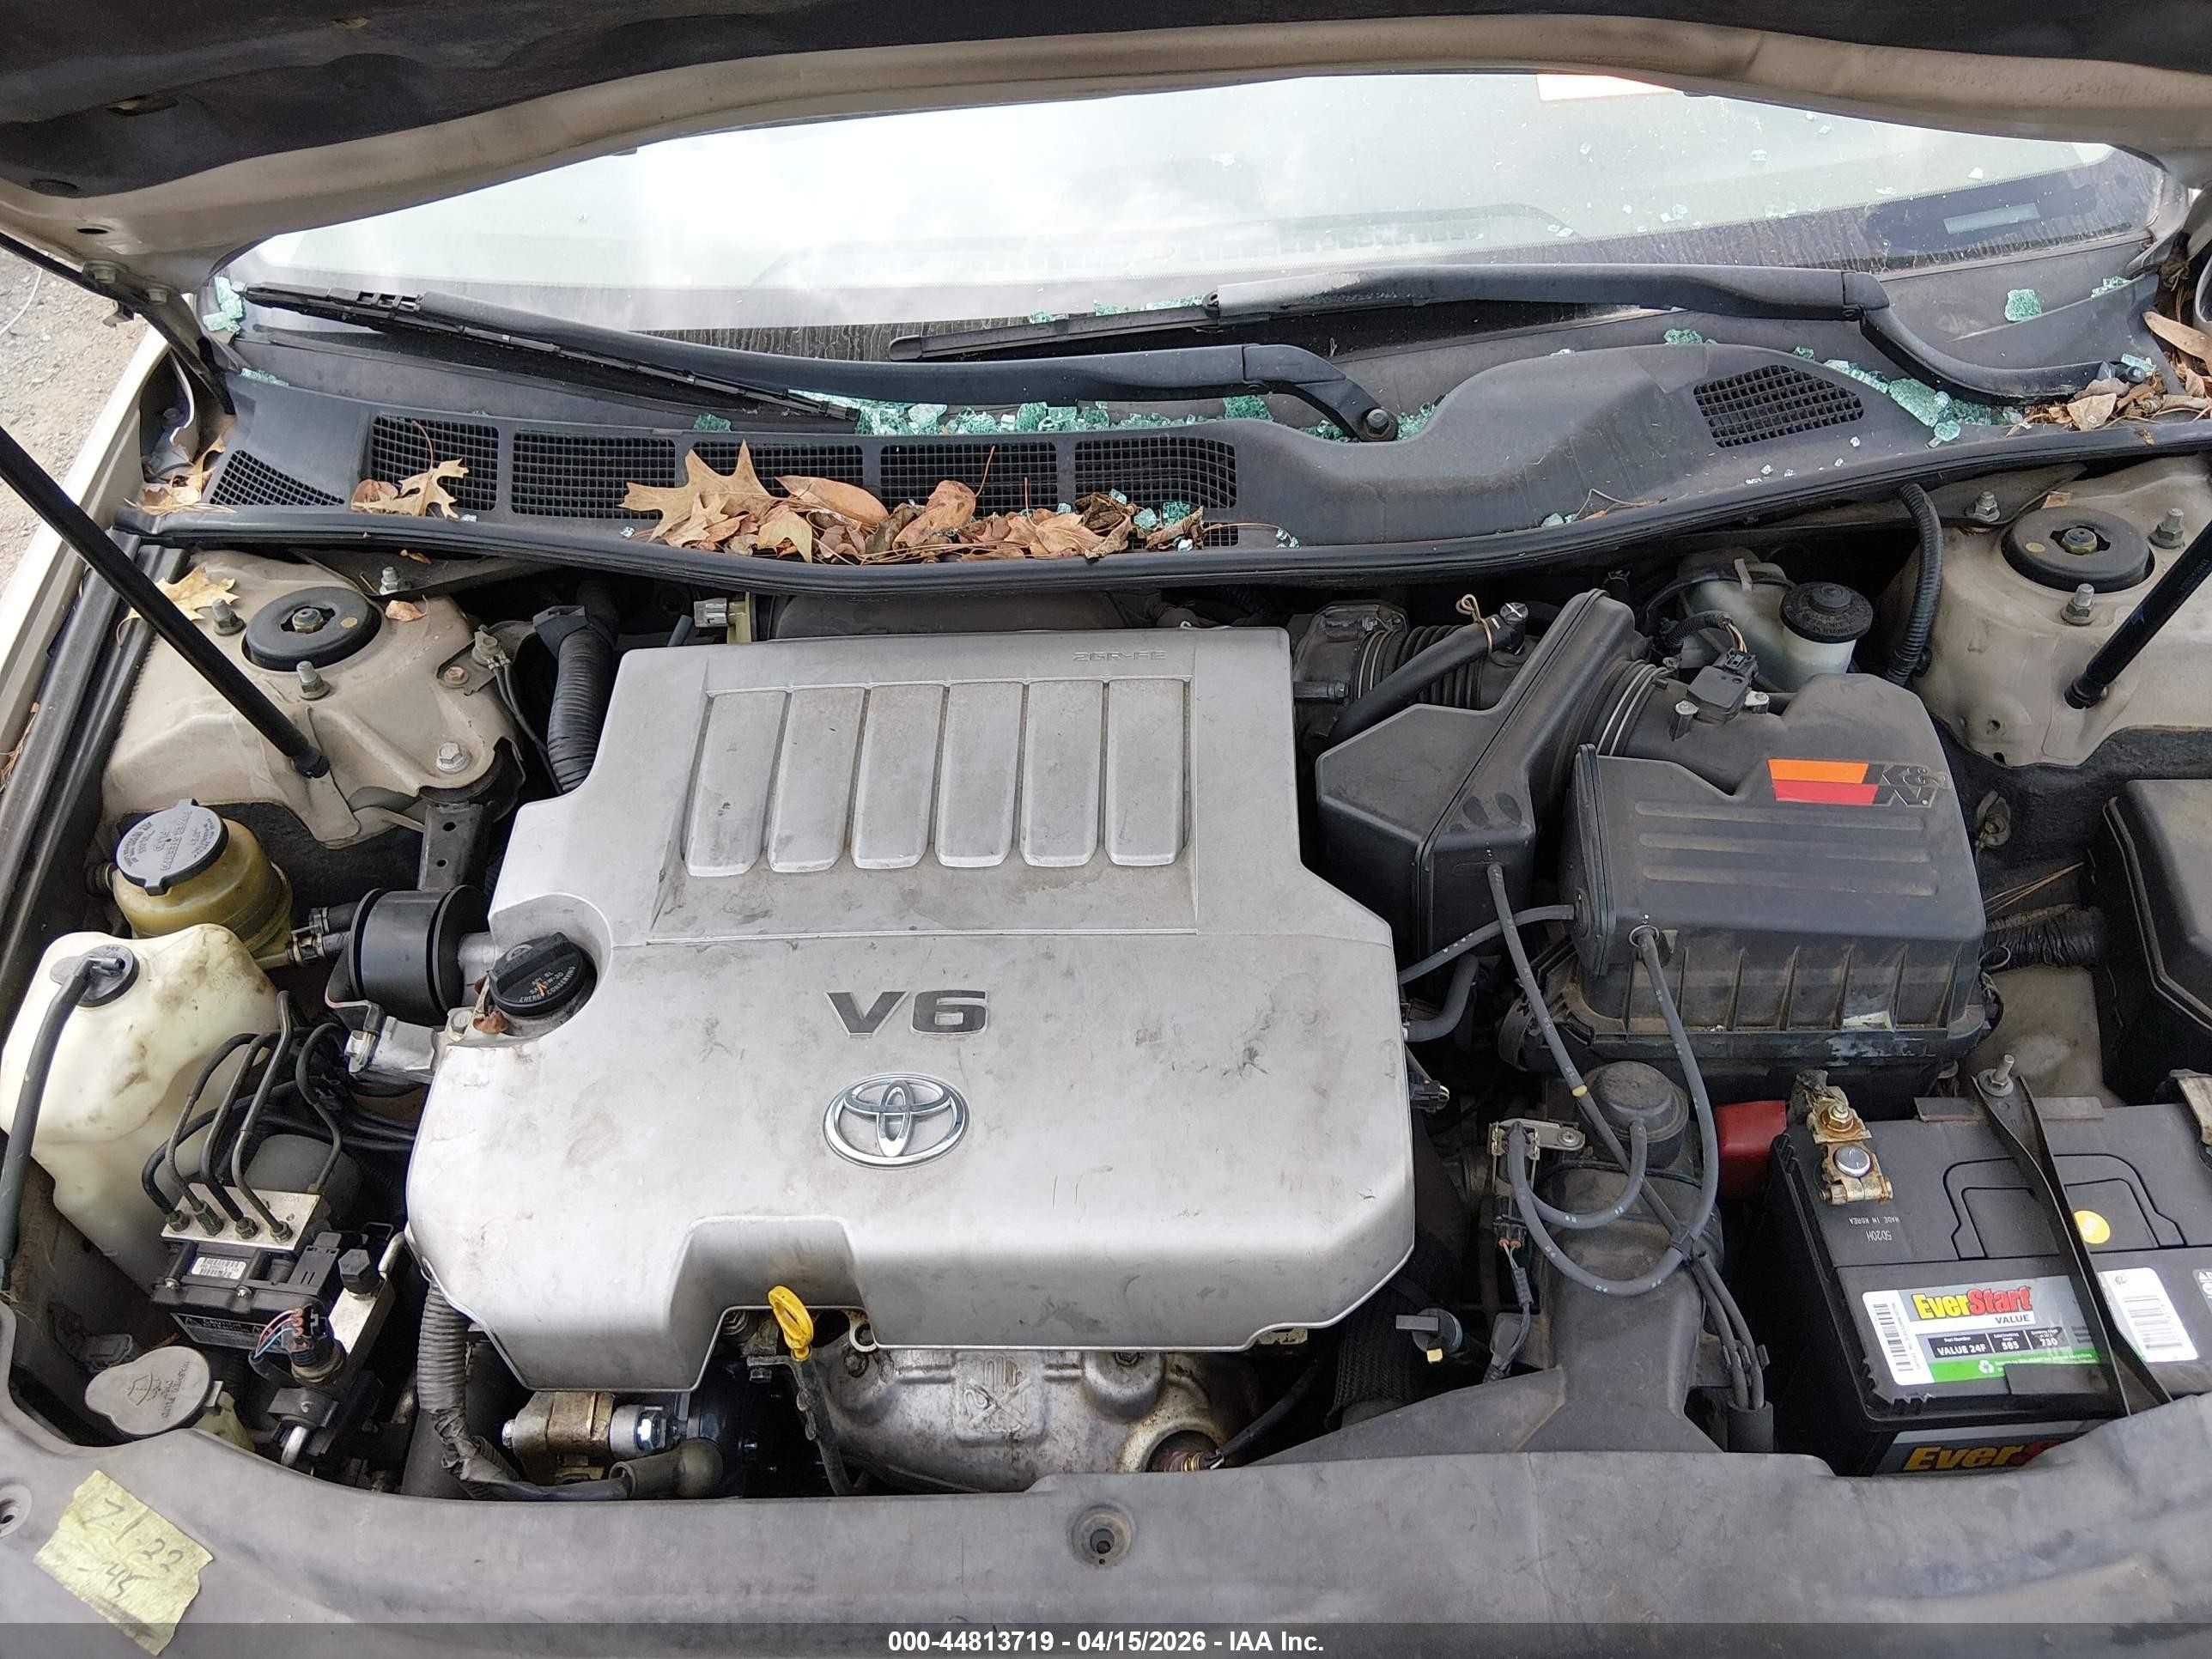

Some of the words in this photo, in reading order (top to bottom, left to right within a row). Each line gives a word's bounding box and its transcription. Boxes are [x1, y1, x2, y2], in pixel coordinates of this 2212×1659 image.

[520, 994, 543, 1003] ENERG
[823, 989, 988, 1036] V6
[1911, 1285, 2033, 1320] EverStart
[1995, 1315, 2031, 1325] VALUE
[2039, 1337, 2058, 1347] 730
[1937, 1344, 1968, 1356] VALUE
[1970, 1343, 1986, 1353] 24F
